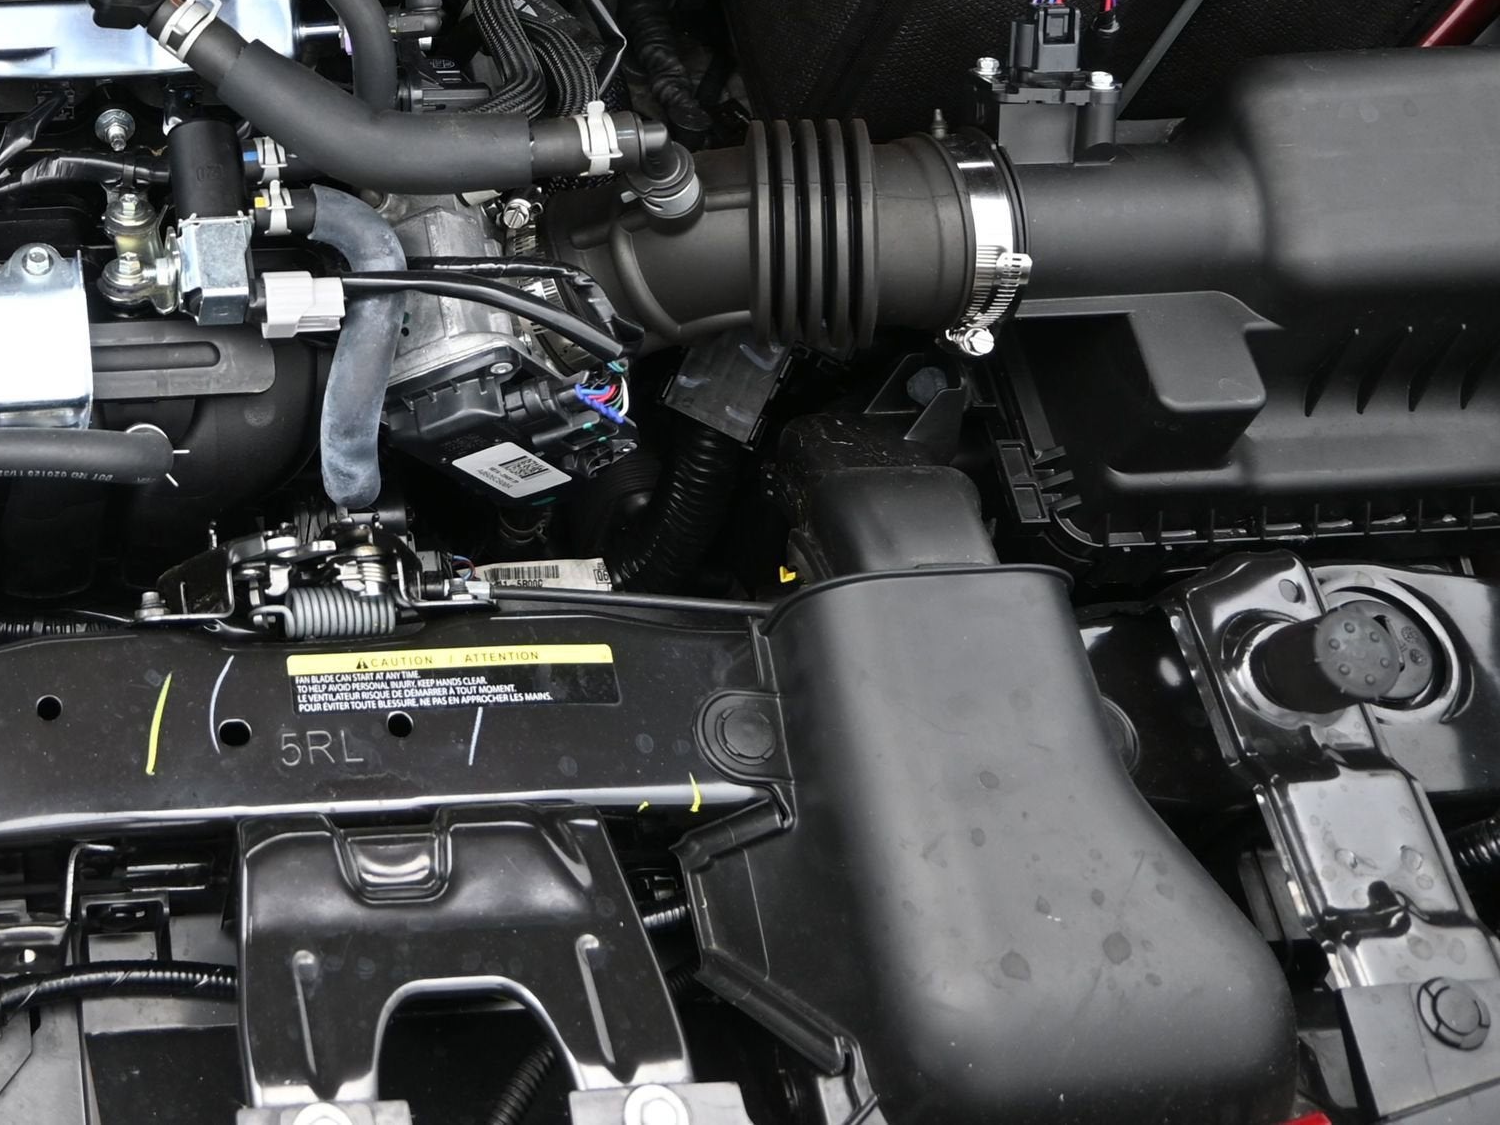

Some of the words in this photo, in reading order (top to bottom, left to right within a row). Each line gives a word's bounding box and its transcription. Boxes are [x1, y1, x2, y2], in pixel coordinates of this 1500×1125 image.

[370, 655, 433, 668] CAUTION
[464, 651, 539, 663] ATTENTION
[295, 676, 310, 684] FAN
[311, 675, 334, 683] BLADE
[336, 674, 351, 682] CAN
[353, 672, 374, 681] START
[375, 672, 385, 680] AT
[386, 671, 400, 679] ANY
[401, 670, 421, 679] TIME.
[297, 685, 307, 693] TO
[309, 684, 327, 693] HELP
[328, 683, 351, 692] AVOID
[352, 681, 389, 691] PERSONAL
[417, 678, 435, 687] KEEP
[436, 677, 462, 686] HANDS
[463, 676, 488, 685] CLEAR.
[297, 694, 307, 703] LE
[308, 692, 360, 703] VENTILATEUR
[361, 690, 390, 700] RISQUE
[391, 690, 404, 699] DE
[405, 686, 448, 698] DÉMARRER
[449, 685, 456, 695] À
[456, 685, 478, 694] TOUT
[478, 684, 517, 694] MOMENT.
[299, 703, 323, 712] POUR
[323, 701, 350, 711] ÉVITER
[350, 700, 377, 710] TOUTE
[419, 697, 431, 706] NE
[432, 696, 448, 706] PAS
[448, 696, 460, 705] EN
[461, 693, 509, 704] APPROCHER
[510, 693, 524, 702] LES
[524, 692, 553, 701] MAINS.
[281, 729, 364, 767] 5RL
